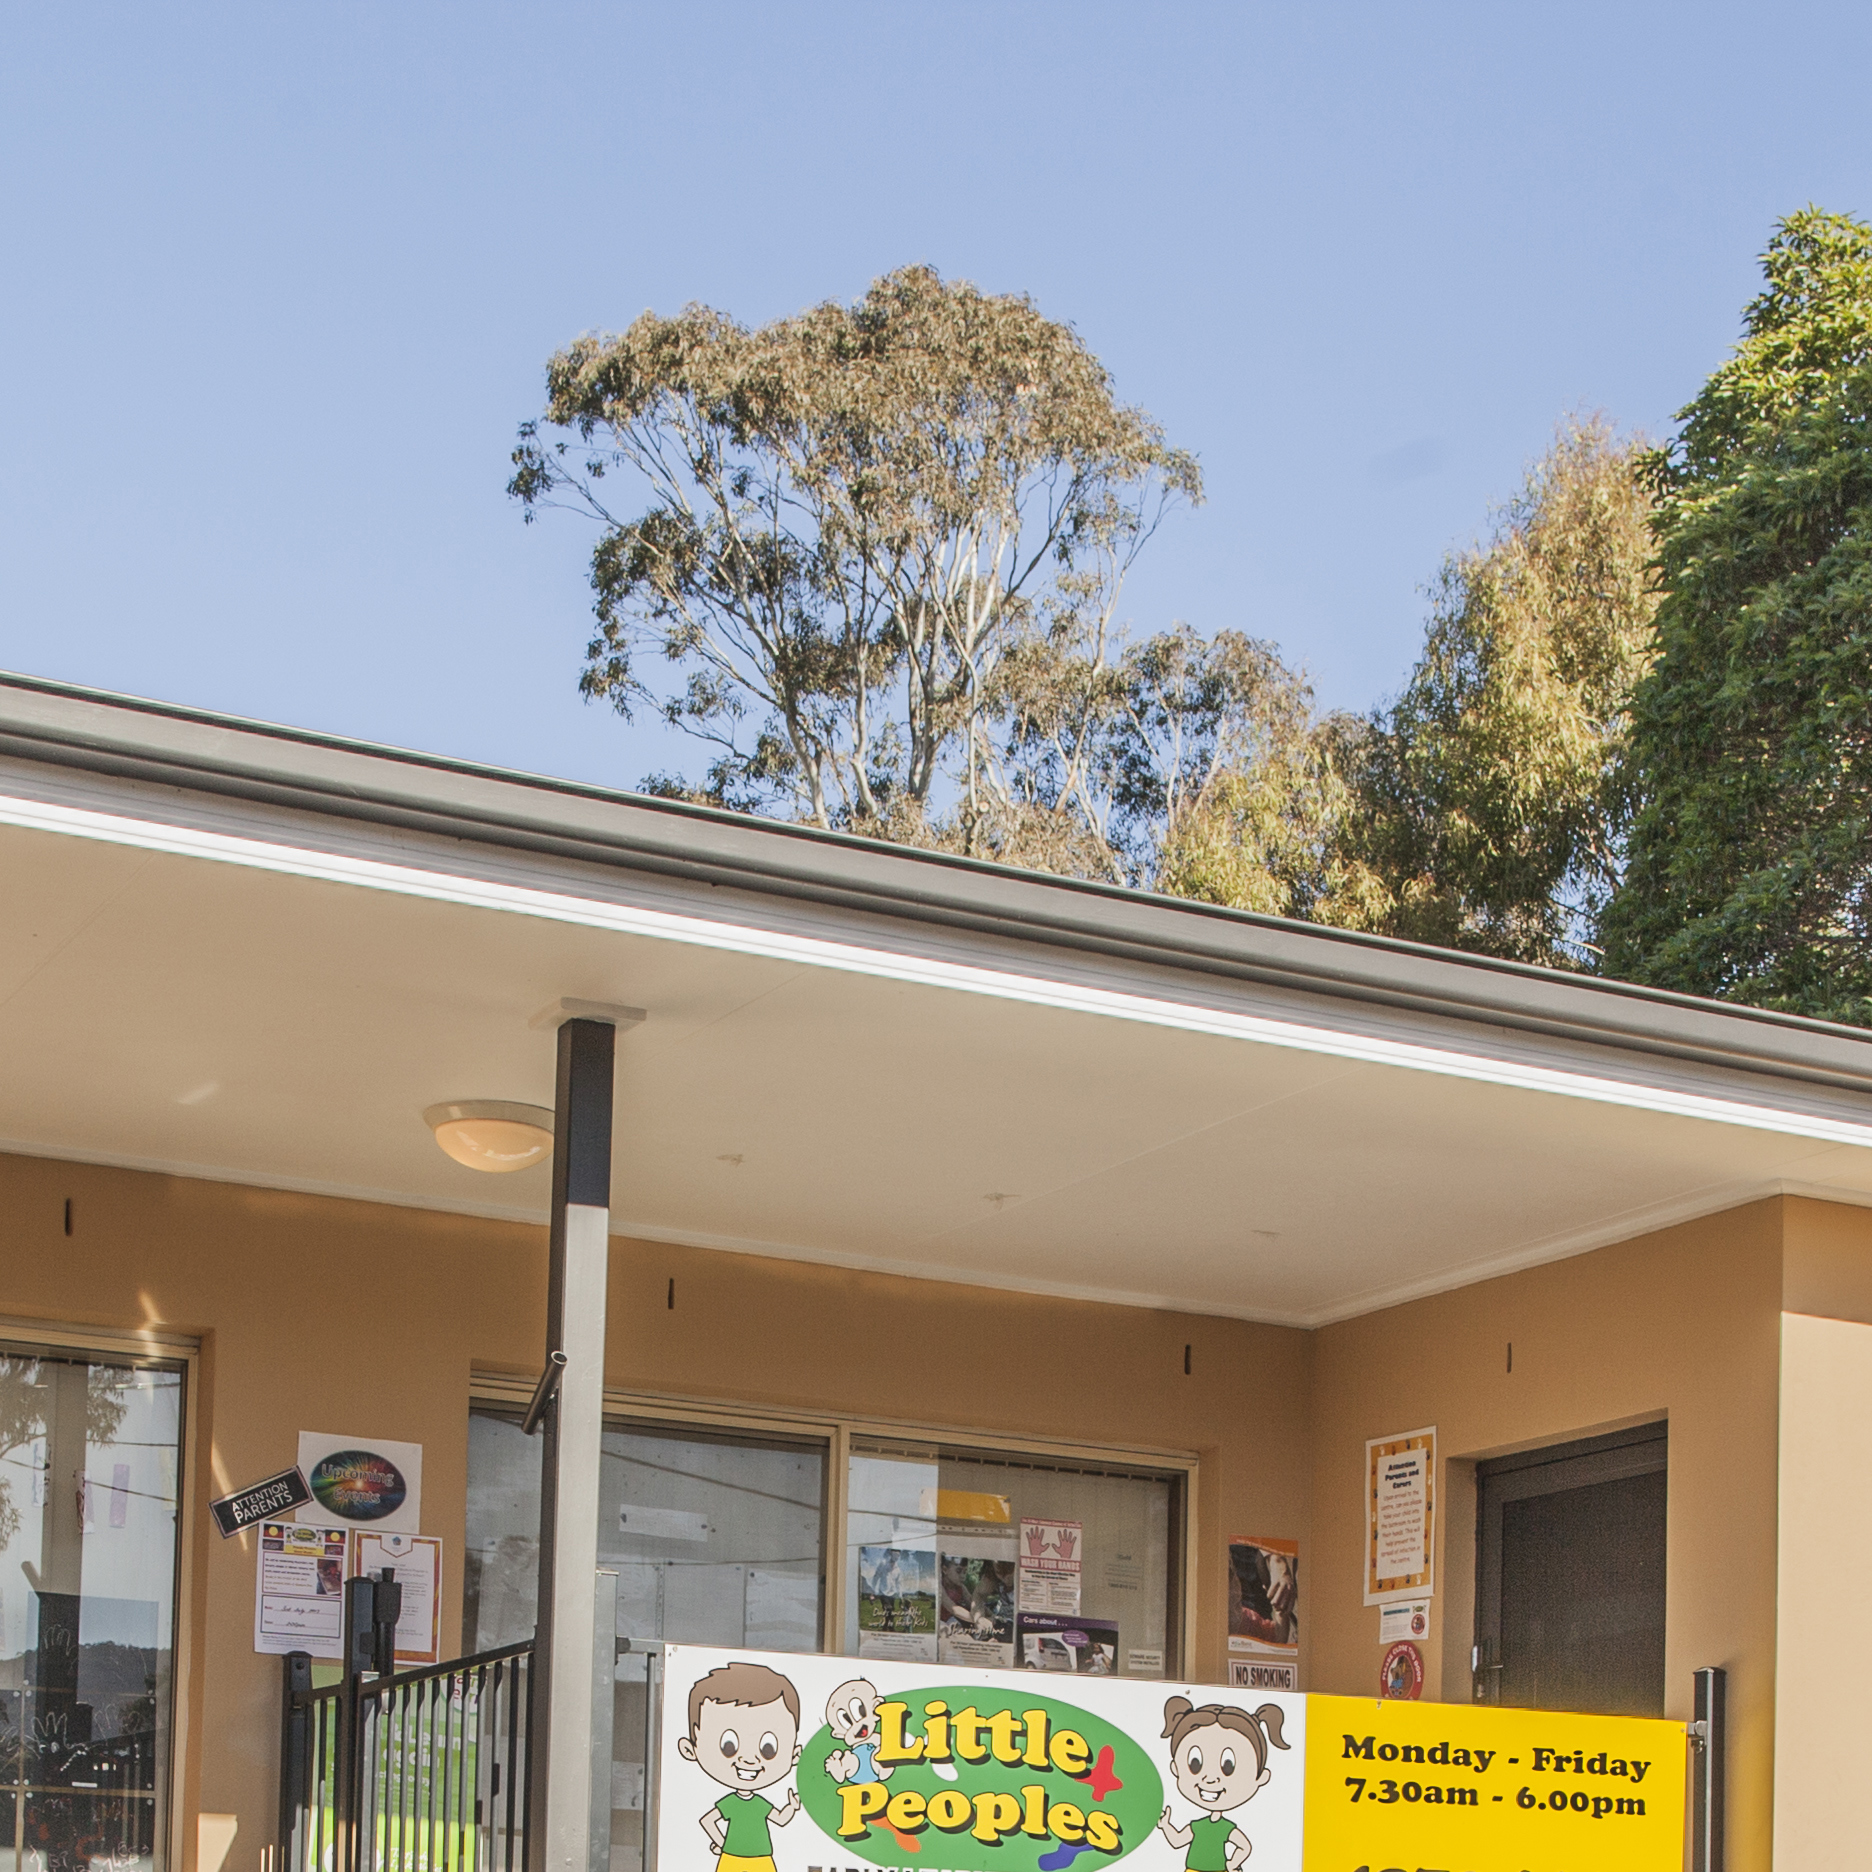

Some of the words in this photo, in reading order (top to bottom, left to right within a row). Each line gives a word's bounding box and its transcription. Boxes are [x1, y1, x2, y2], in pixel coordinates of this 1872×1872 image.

[322, 1464, 395, 1487] Upcoming
[232, 1481, 288, 1512] ATTENTION
[234, 1491, 293, 1524] PARENTS
[333, 1487, 381, 1504] Events
[1040, 1559, 1057, 1569] YOUR
[1057, 1561, 1080, 1571] HANDS
[1023, 1616, 1038, 1624] Cars
[1236, 1666, 1248, 1685] NO
[1251, 1667, 1290, 1688] SMOKING
[874, 1700, 1092, 1776] Little
[1341, 1734, 1497, 1774] Monday
[1508, 1757, 1520, 1765] -
[1532, 1747, 1652, 1783] Friday
[1345, 1776, 1479, 1806] 7.30am
[1492, 1794, 1503, 1802] -
[1515, 1786, 1647, 1819] 6.00pm
[836, 1781, 1123, 1855] Peoples
